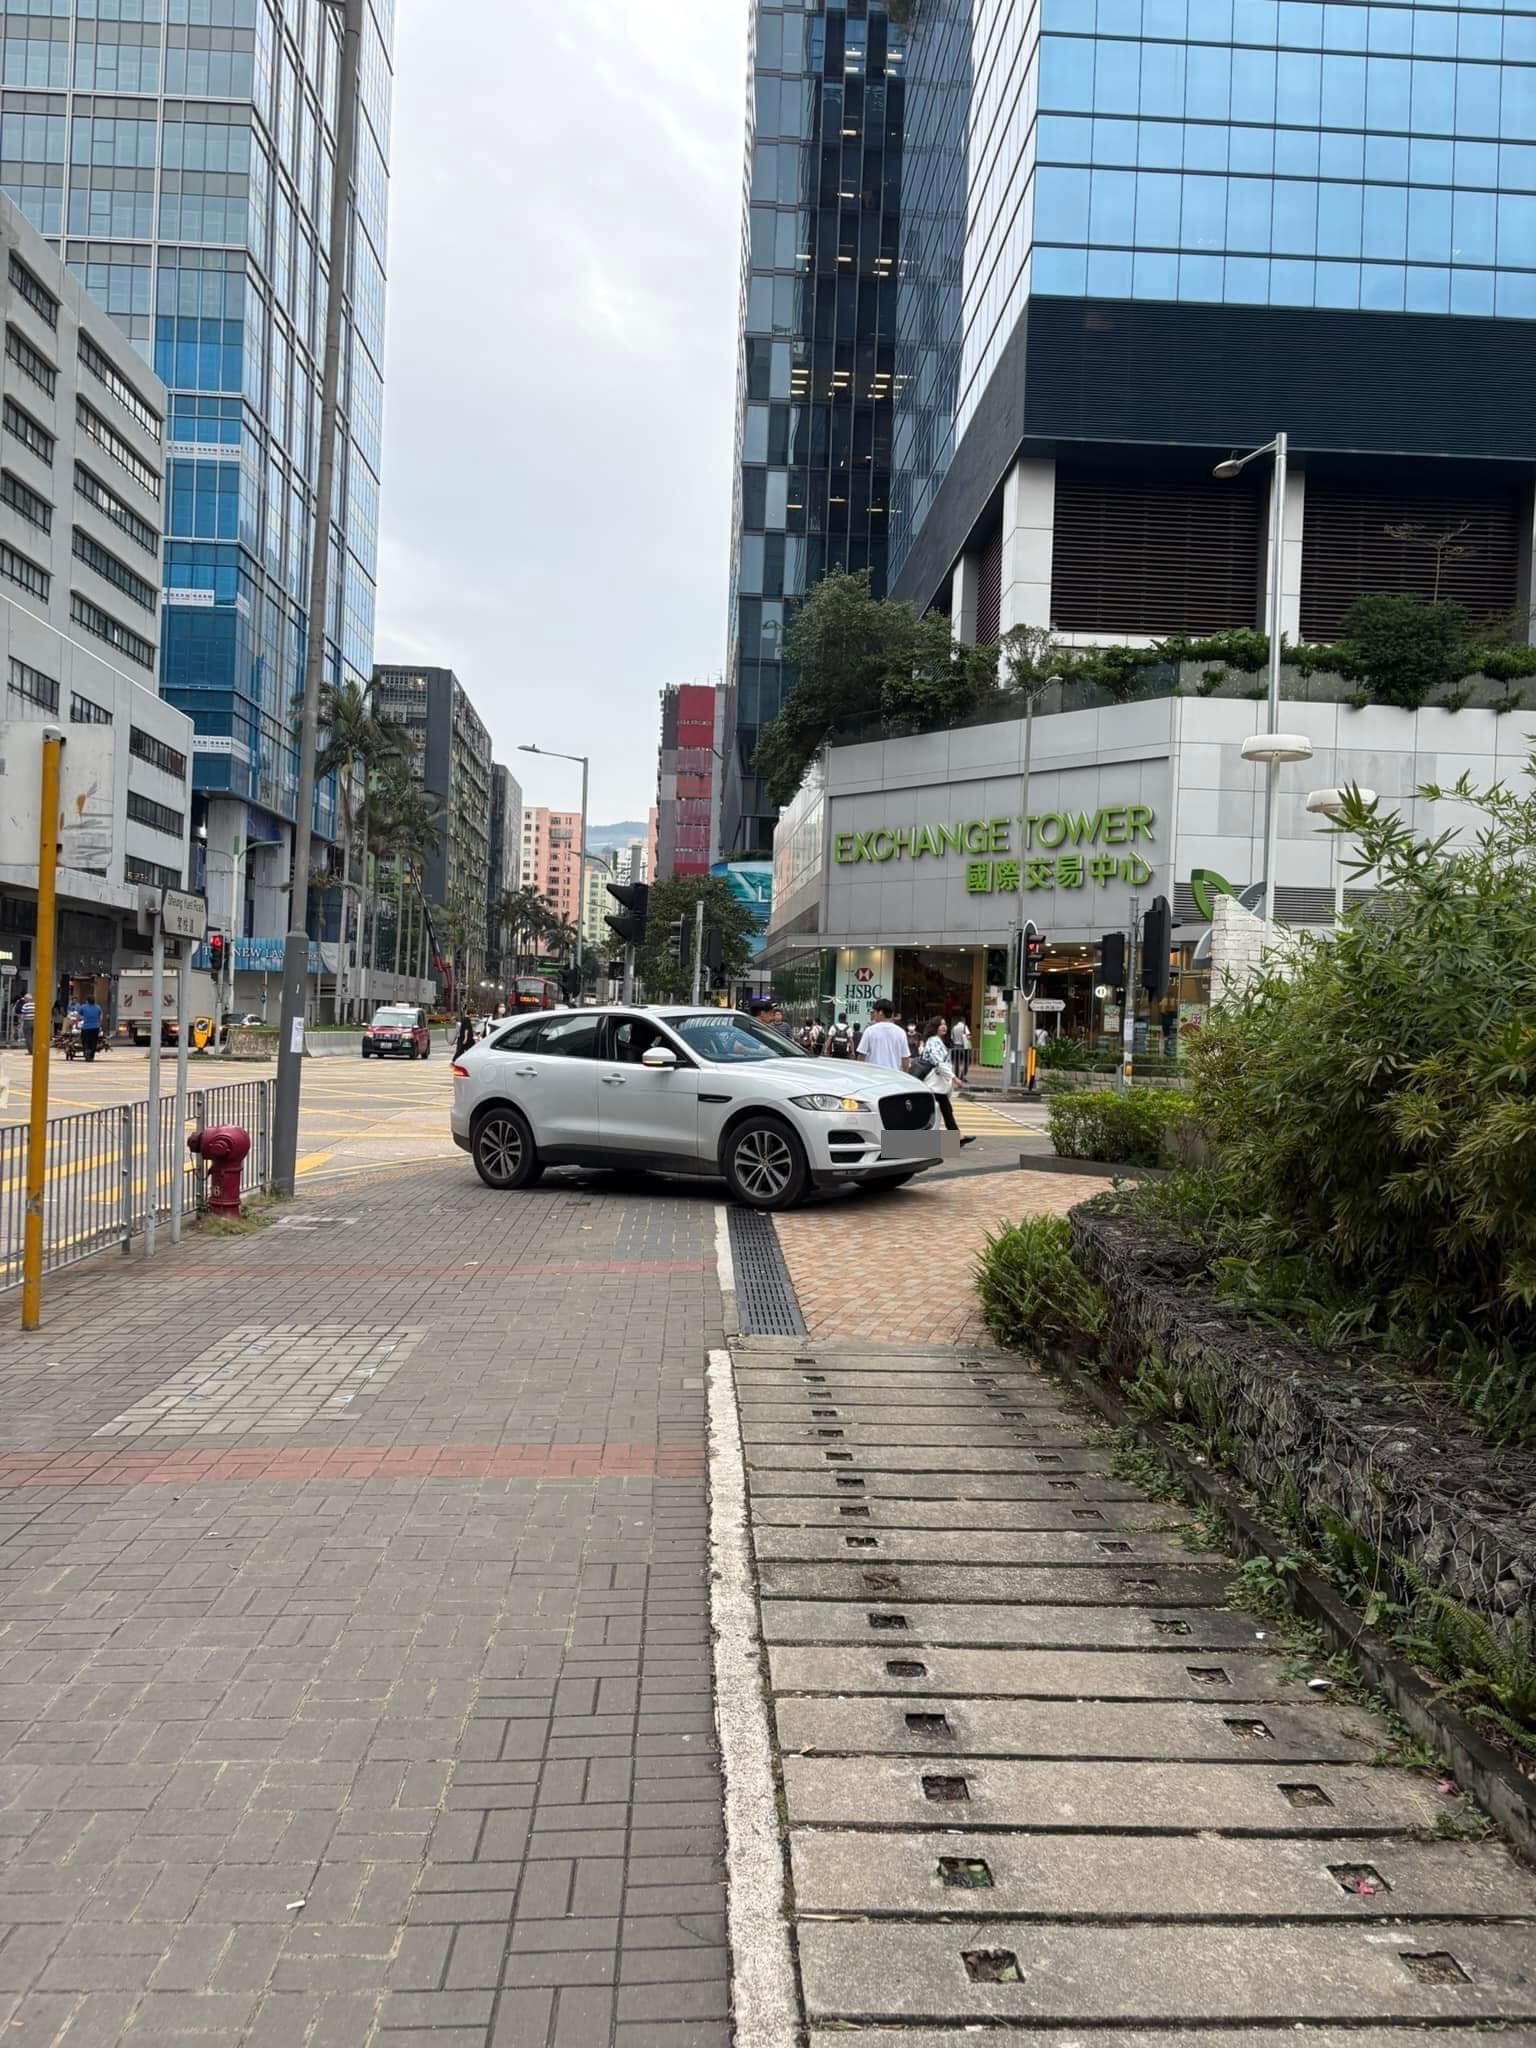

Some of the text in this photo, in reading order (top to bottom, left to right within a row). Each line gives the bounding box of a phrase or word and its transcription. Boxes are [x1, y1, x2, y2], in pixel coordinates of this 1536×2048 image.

[832, 805, 1154, 864] EXCHANGE TOWER
[966, 850, 1153, 894] 國際交易中心
[845, 984, 882, 1000] HSBC
